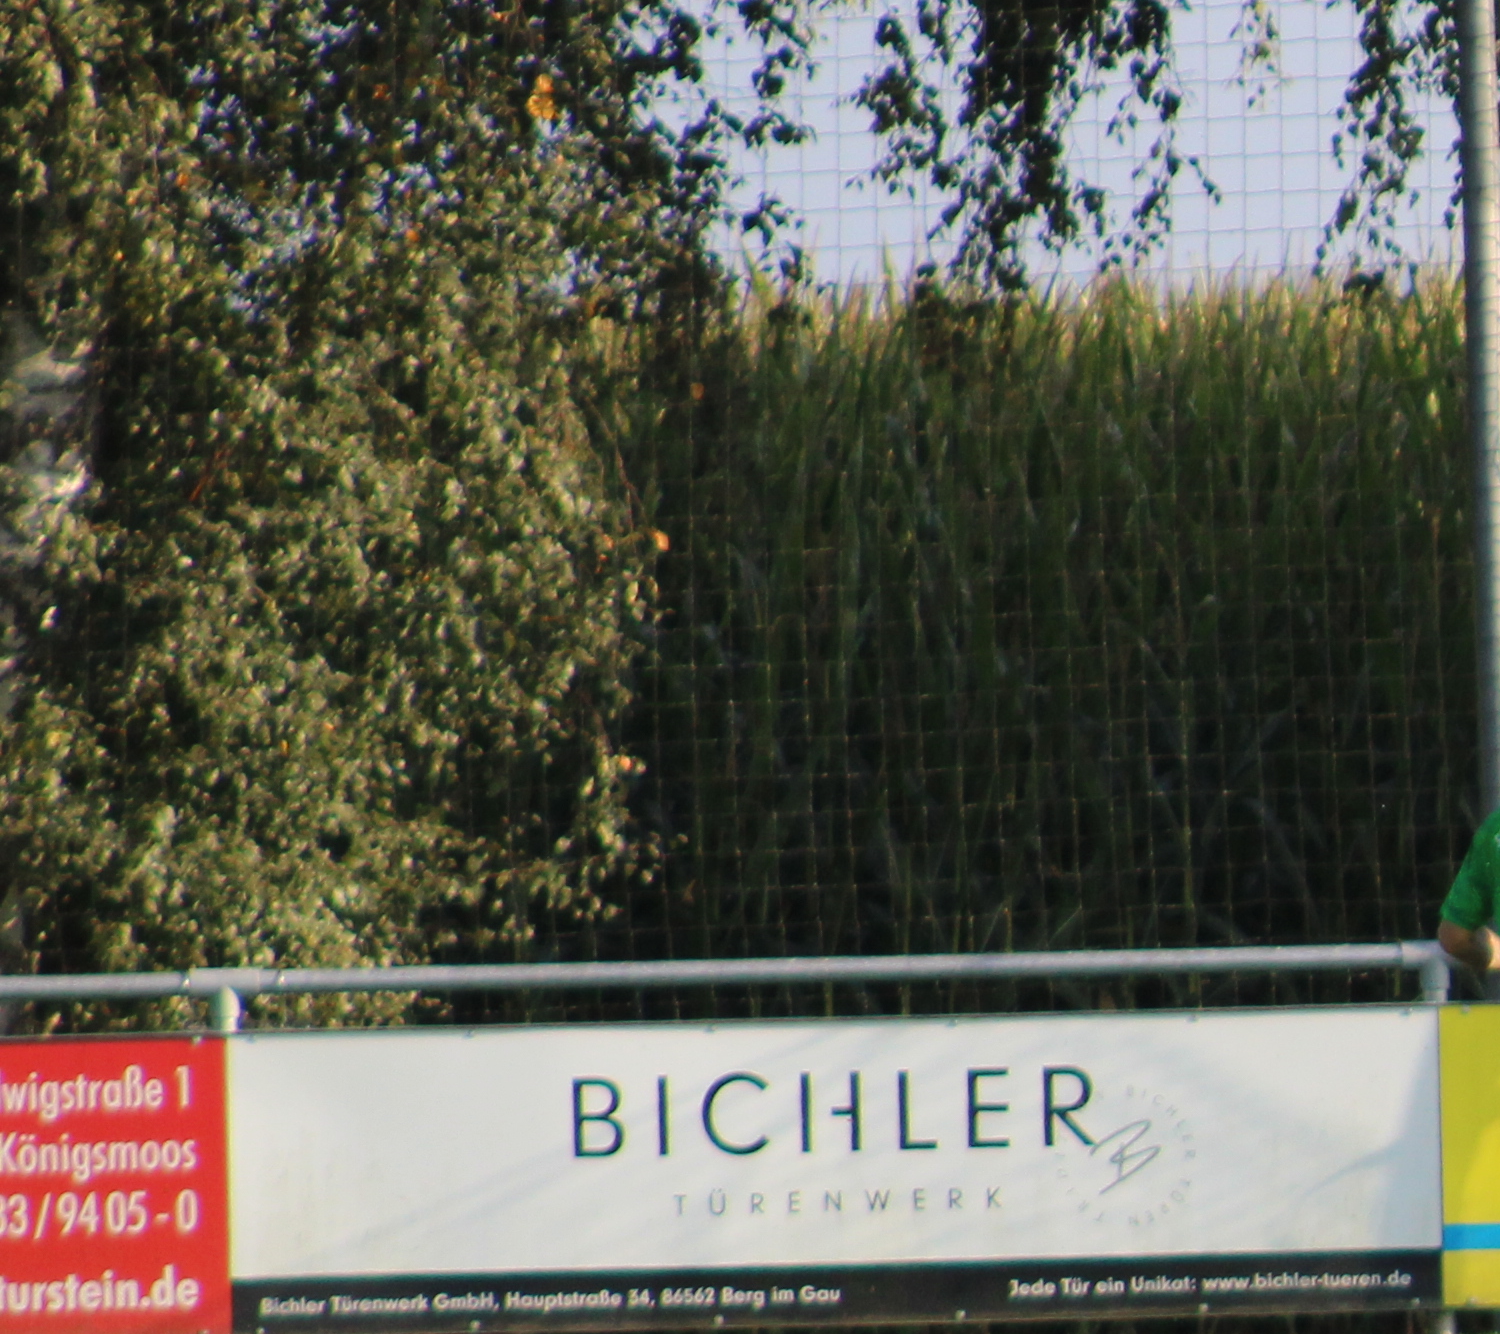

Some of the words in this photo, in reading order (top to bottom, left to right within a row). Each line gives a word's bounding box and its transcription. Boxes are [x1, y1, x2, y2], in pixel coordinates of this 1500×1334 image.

[175, 1065, 191, 1108] 1
[572, 1065, 1096, 1157] BICHLER
[674, 1187, 1001, 1217] TÜRENWERK
[1009, 1278, 1056, 1297] Jede
[1060, 1275, 1089, 1295] Tür
[1095, 1276, 1125, 1294] ein
[1130, 1273, 1197, 1292] Unikat:
[1201, 1269, 1412, 1291] www.bichler-tueren.de
[260, 1296, 326, 1315] Bichler
[330, 1293, 428, 1314] Türenwerk
[432, 1291, 499, 1312] GmbH,
[505, 1288, 622, 1315] Hauptstraße
[628, 1287, 655, 1307] 34,
[660, 1286, 715, 1305] 86562
[720, 1285, 764, 1310] Berg
[771, 1285, 794, 1303] im
[800, 1284, 840, 1304] Gau
